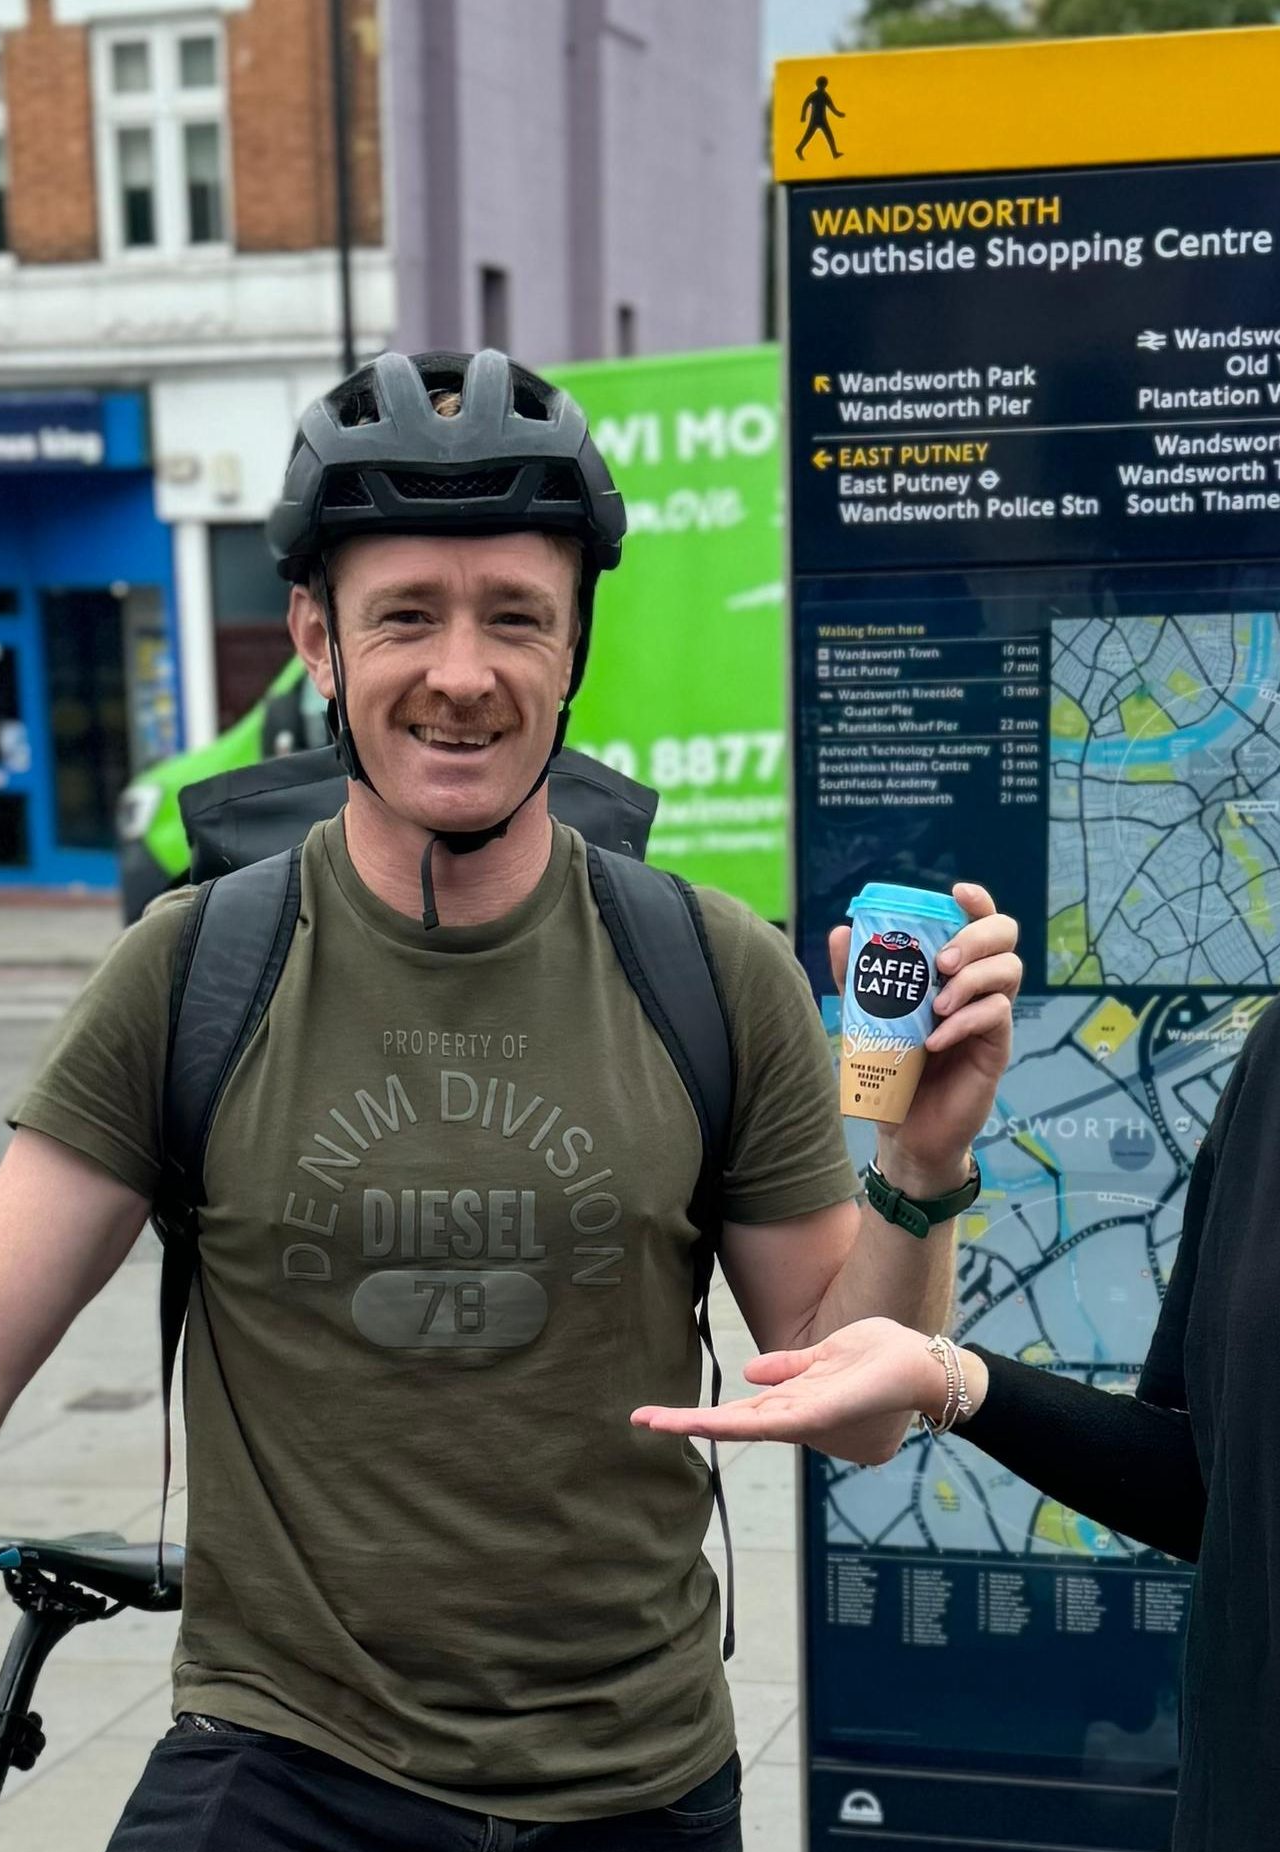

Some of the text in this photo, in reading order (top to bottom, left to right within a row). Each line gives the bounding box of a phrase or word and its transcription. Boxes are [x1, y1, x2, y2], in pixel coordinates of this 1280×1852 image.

[812, 196, 1060, 236] WANDSWORTH
[811, 228, 1273, 277] Southside Shopping Centre
[1226, 354, 1268, 376] Old
[839, 365, 1036, 394] Wandsworth Park
[839, 396, 1031, 422] Wandsworth Pier
[1138, 385, 1259, 410] Plantation
[676, 402, 782, 462] MO
[38, 426, 104, 466] king
[839, 443, 989, 467] EAST PUTNEY
[839, 472, 970, 495] East Putney
[1119, 460, 1266, 486] Wandsworth
[840, 495, 1099, 523] Wandsworth Police Stn
[1127, 493, 1194, 515] South
[818, 623, 925, 639] Walking from here
[833, 644, 1039, 660] Wandsworth Town 10 min
[833, 661, 1039, 679] East Putney 17 min
[838, 685, 1039, 700] Wandsworth Riverside 13 min
[844, 704, 913, 717] Quarter Pier
[838, 719, 1039, 734] Plantation Wharf Pier 22 min
[650, 731, 785, 788] 8877
[819, 745, 868, 757] Ashcroft
[871, 744, 935, 758] Technology
[937, 743, 991, 757] Academy
[1017, 742, 1039, 753] min
[890, 760, 927, 772] Health
[931, 760, 969, 772] Centre
[1017, 759, 1039, 770] min
[819, 775, 1038, 791] Southfields Academy 19 min
[844, 794, 879, 806] Prison
[881, 793, 953, 805] Wandsworth
[1000, 793, 1012, 804] 21
[1016, 792, 1038, 803] min
[859, 955, 926, 982] CAFFÈ
[857, 975, 919, 1001] LATTE
[383, 1030, 529, 1060] PROPERTY OF
[845, 1024, 915, 1065] Skinny
[1166, 1028, 1248, 1041] Wandsworth
[982, 1117, 1145, 1140] DSWORTH
[282, 1070, 625, 1286] DENIM DIVISION
[362, 1188, 546, 1260] DIESEL
[413, 1279, 486, 1336] 78
